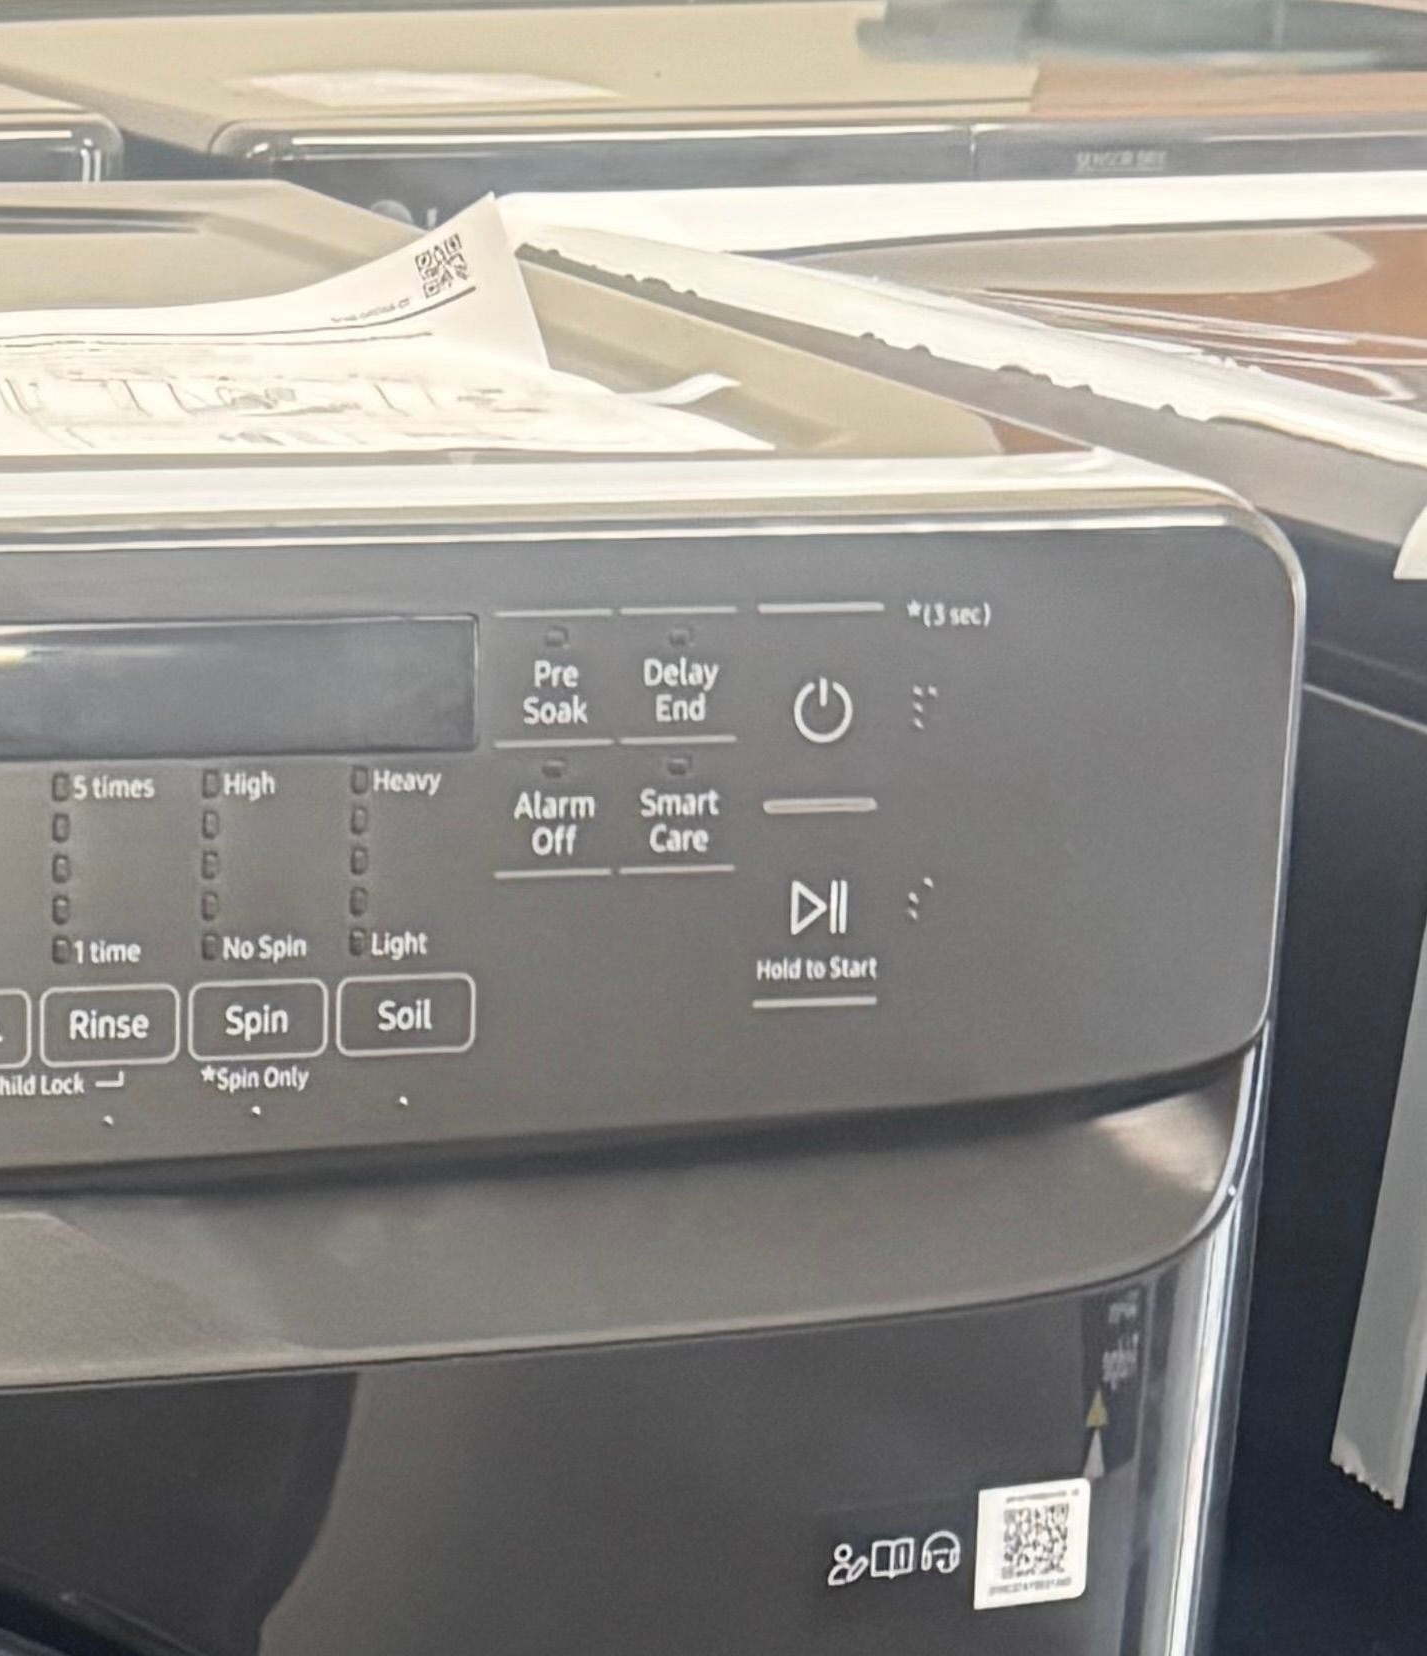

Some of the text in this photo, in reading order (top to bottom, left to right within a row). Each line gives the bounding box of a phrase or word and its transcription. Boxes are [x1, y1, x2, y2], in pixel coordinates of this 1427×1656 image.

[949, 602, 991, 628] sec)
[534, 660, 579, 688] Pre
[643, 656, 719, 691] Delay
[523, 695, 588, 725] Soak
[655, 692, 706, 722] End
[73, 775, 155, 800] 5 times
[223, 770, 275, 801] High
[373, 769, 441, 796] Heavy
[514, 790, 595, 820] Alarm
[640, 788, 720, 818] Smart
[532, 824, 577, 855] Off
[649, 823, 709, 853] Care
[74, 940, 142, 965] 1 time
[223, 934, 307, 963] No Spin
[371, 931, 427, 960] Light
[757, 955, 877, 981] Hold to Start
[69, 1009, 150, 1040] Rinse
[225, 1004, 288, 1042] Spin
[378, 998, 433, 1031] Soil
[40, 1071, 85, 1096] Lock
[264, 1064, 309, 1091] Only
